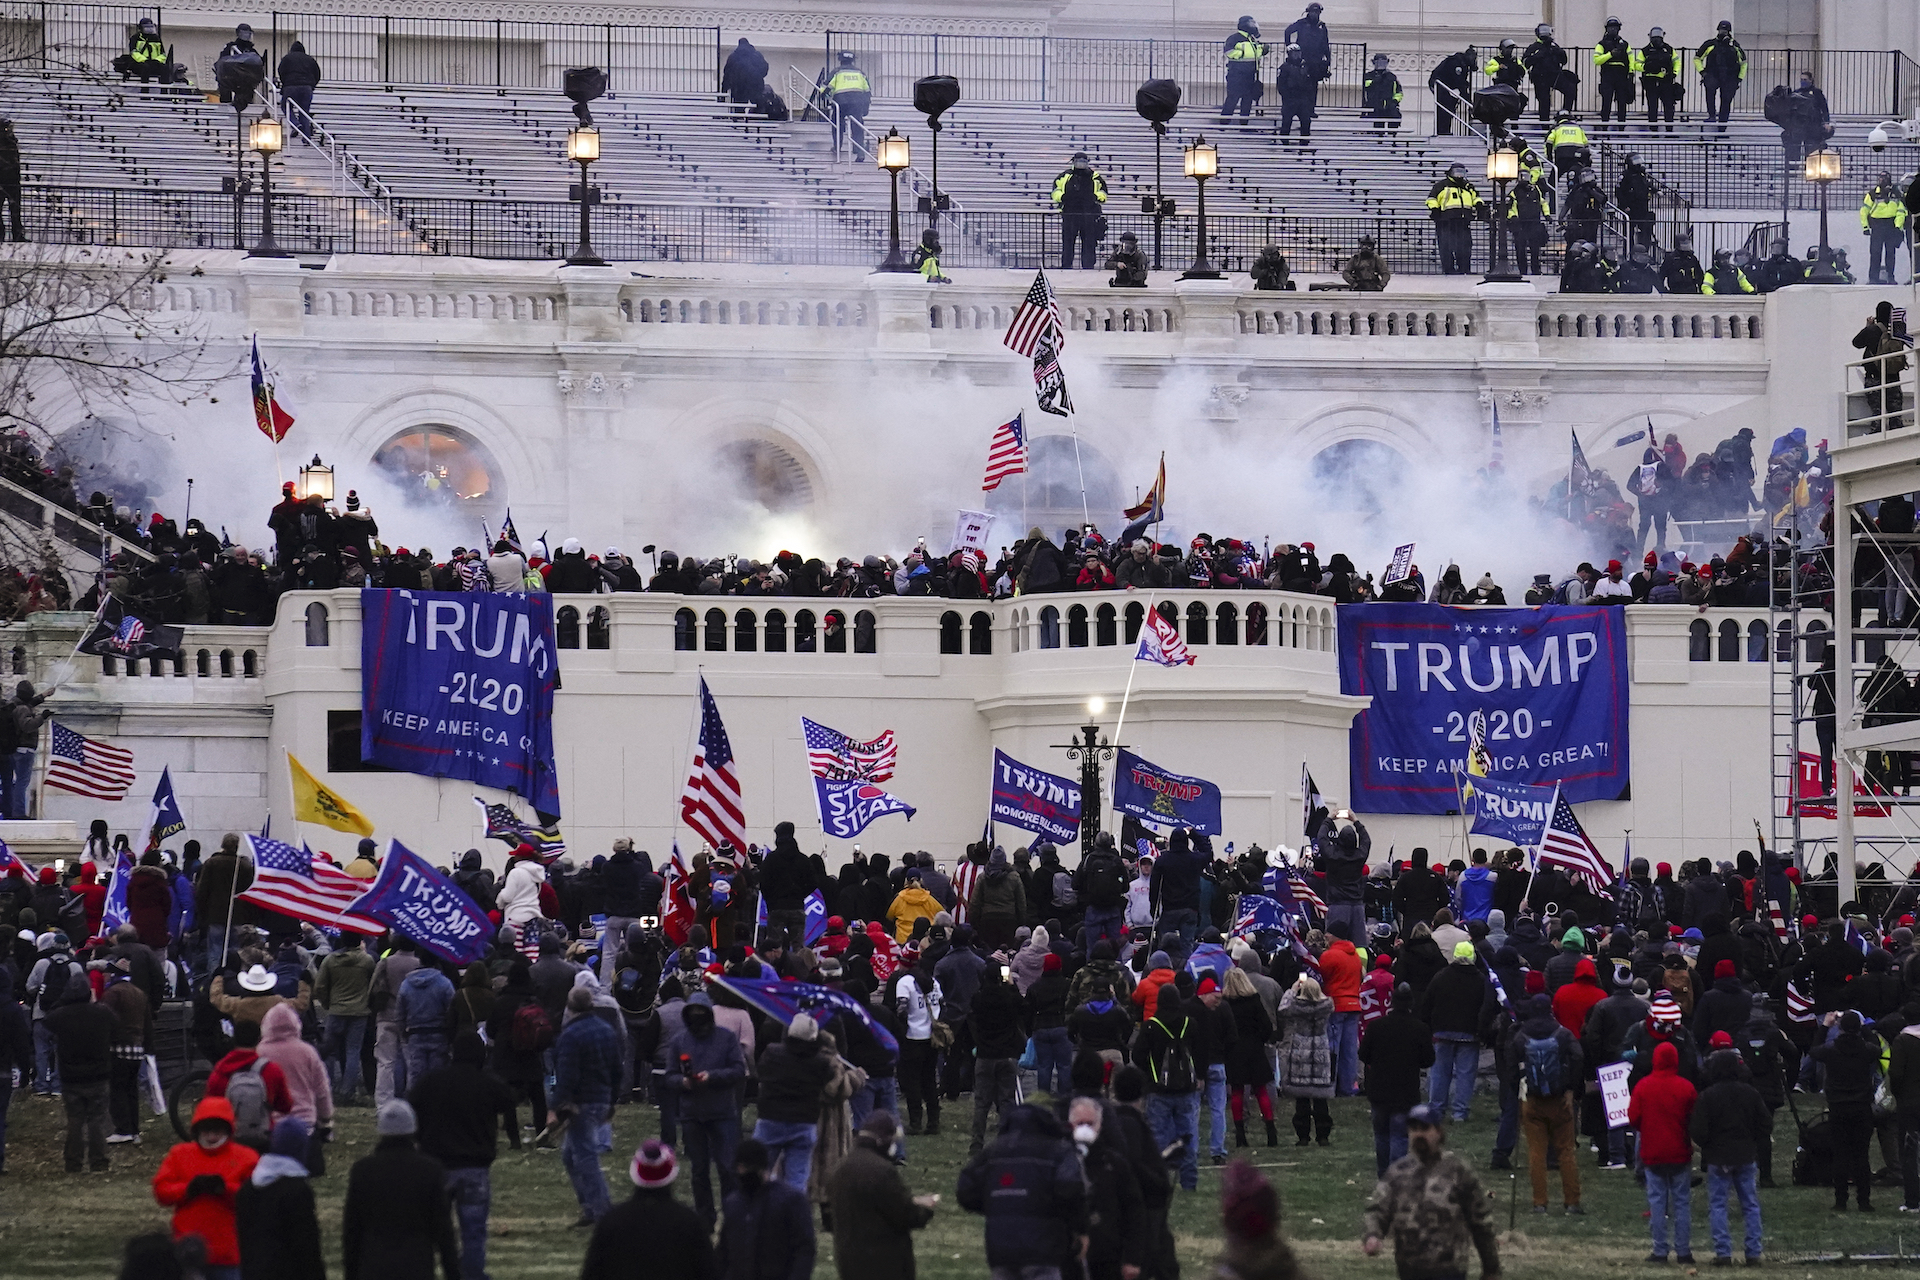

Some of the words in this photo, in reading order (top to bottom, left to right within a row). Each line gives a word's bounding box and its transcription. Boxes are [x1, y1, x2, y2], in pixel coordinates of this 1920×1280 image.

[1397, 545, 1412, 578] TRUMP
[1371, 632, 1598, 693] TRUMP
[381, 708, 430, 731] KEEP
[847, 738, 884, 755] GUNS
[1378, 756, 1428, 774] KEEP
[1435, 756, 1530, 773] AMICA
[1538, 742, 1609, 768] GREAT!
[826, 782, 850, 791] FIGHT
[999, 759, 1082, 810] TRUMP
[1131, 769, 1202, 802] TRUMP
[994, 803, 1010, 815] NO
[1010, 807, 1040, 825] MORE
[1125, 803, 1145, 814] KEEP
[1146, 810, 1180, 824] AMERICA
[399, 865, 482, 940] TRUMP
[1601, 1069, 1624, 1083] KEEP
[1606, 1092, 1618, 1101] TO
